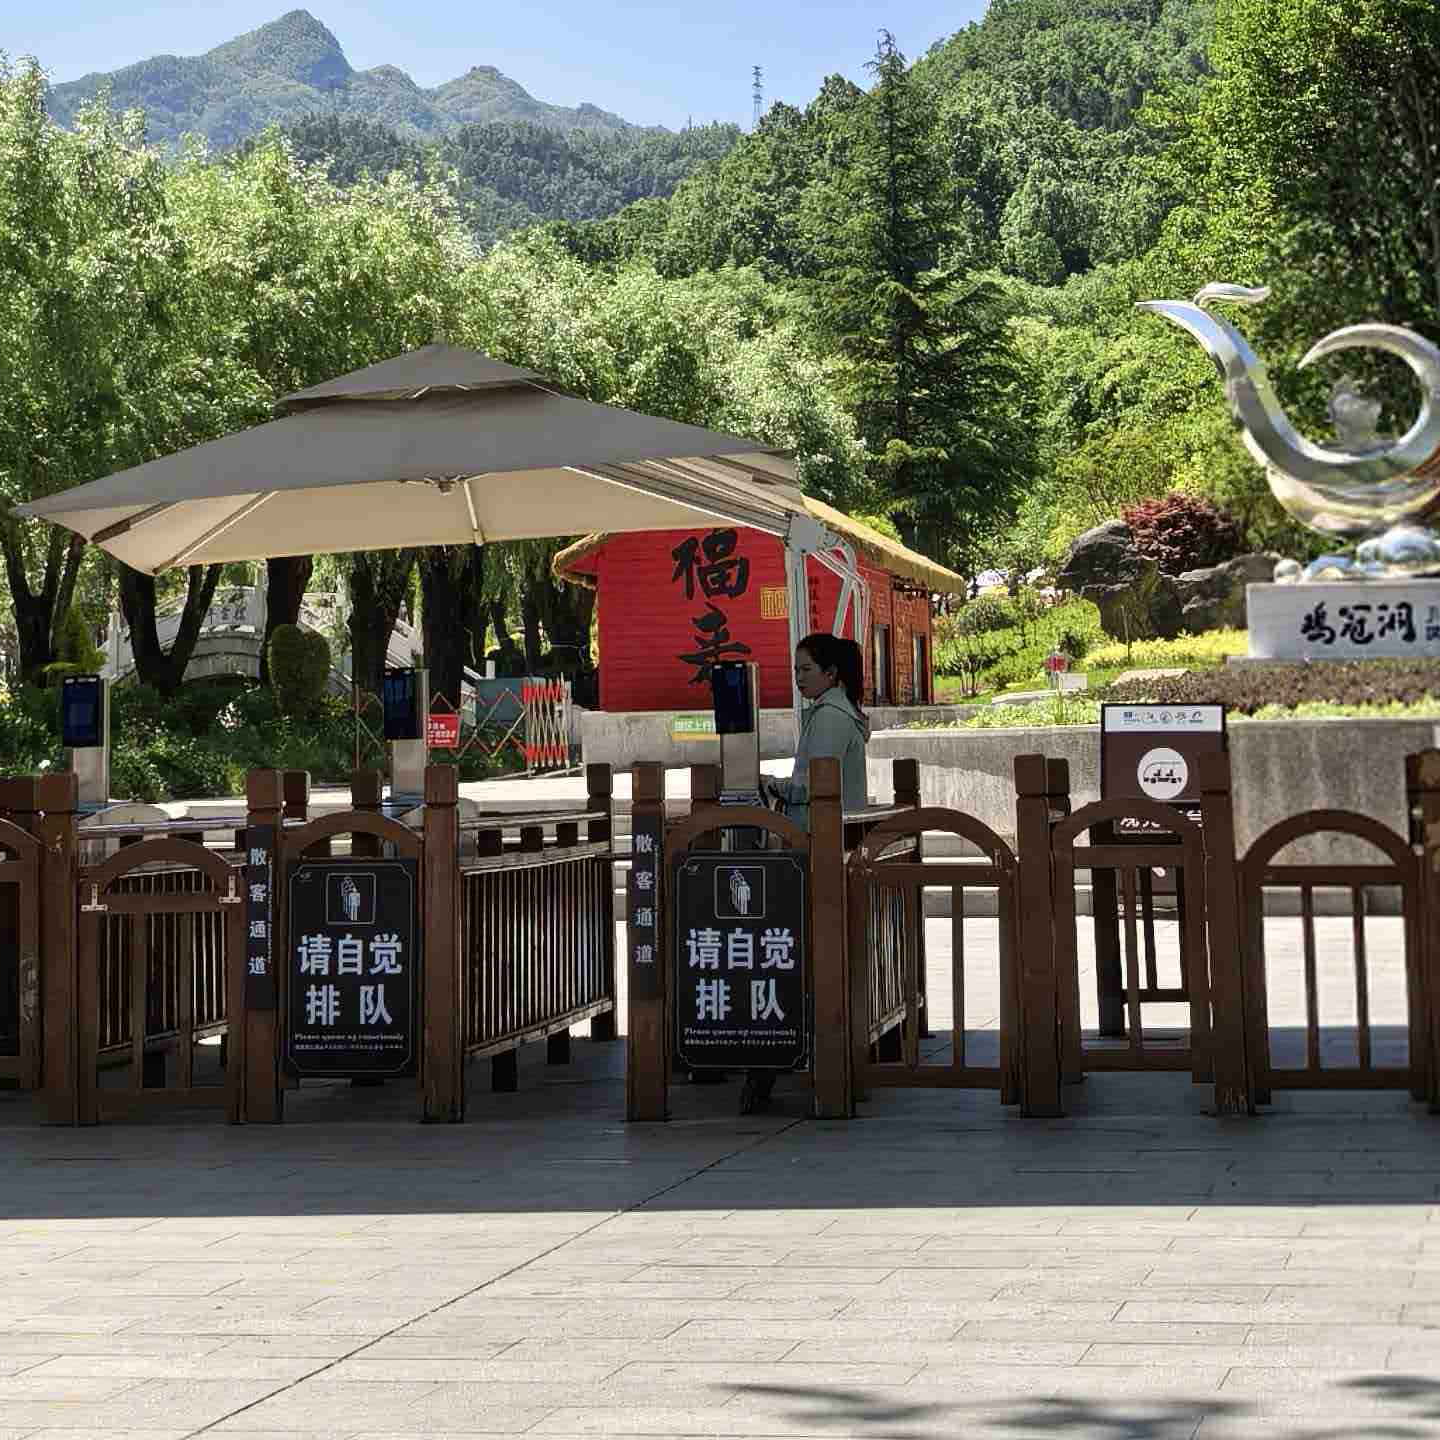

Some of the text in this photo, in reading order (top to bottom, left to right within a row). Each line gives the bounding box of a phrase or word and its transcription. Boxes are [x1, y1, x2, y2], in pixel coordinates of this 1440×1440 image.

[248, 847, 267, 976] 散客通道
[635, 833, 654, 963] 散客通道
[297, 933, 402, 975] 请自觉
[686, 927, 795, 969] 请自觉
[305, 983, 393, 1026] 排队
[695, 978, 786, 1021] 排队
